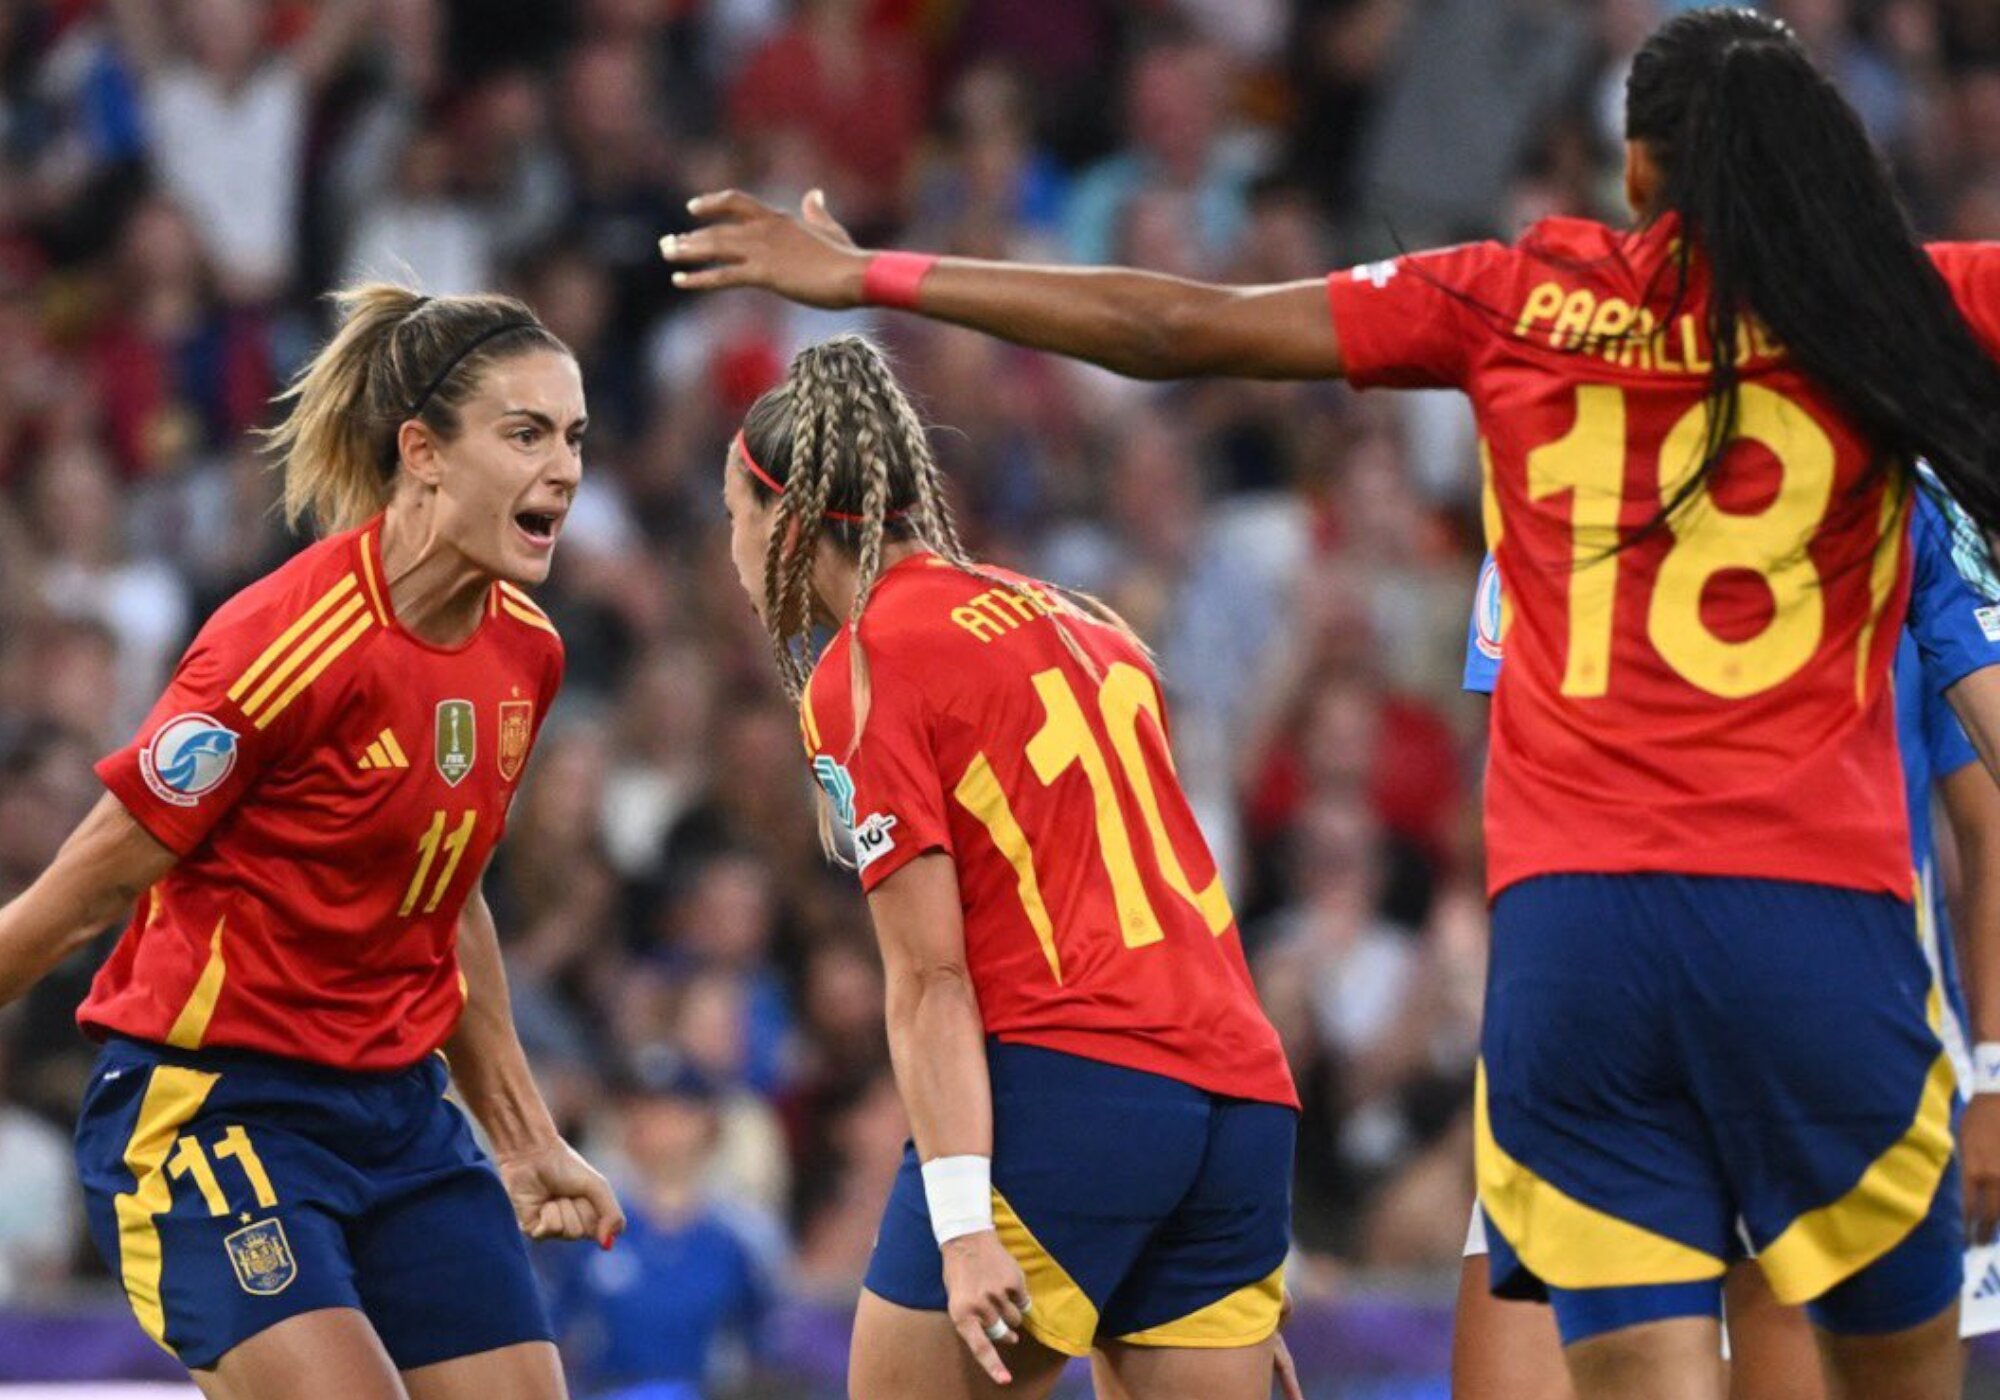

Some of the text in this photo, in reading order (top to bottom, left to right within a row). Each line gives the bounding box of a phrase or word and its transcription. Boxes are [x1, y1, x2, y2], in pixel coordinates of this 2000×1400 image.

[1527, 380, 1836, 698] 18
[950, 581, 1066, 643] ATHE
[1025, 661, 1234, 949] 10
[398, 809, 477, 916] 11
[167, 1125, 278, 1217] 11
